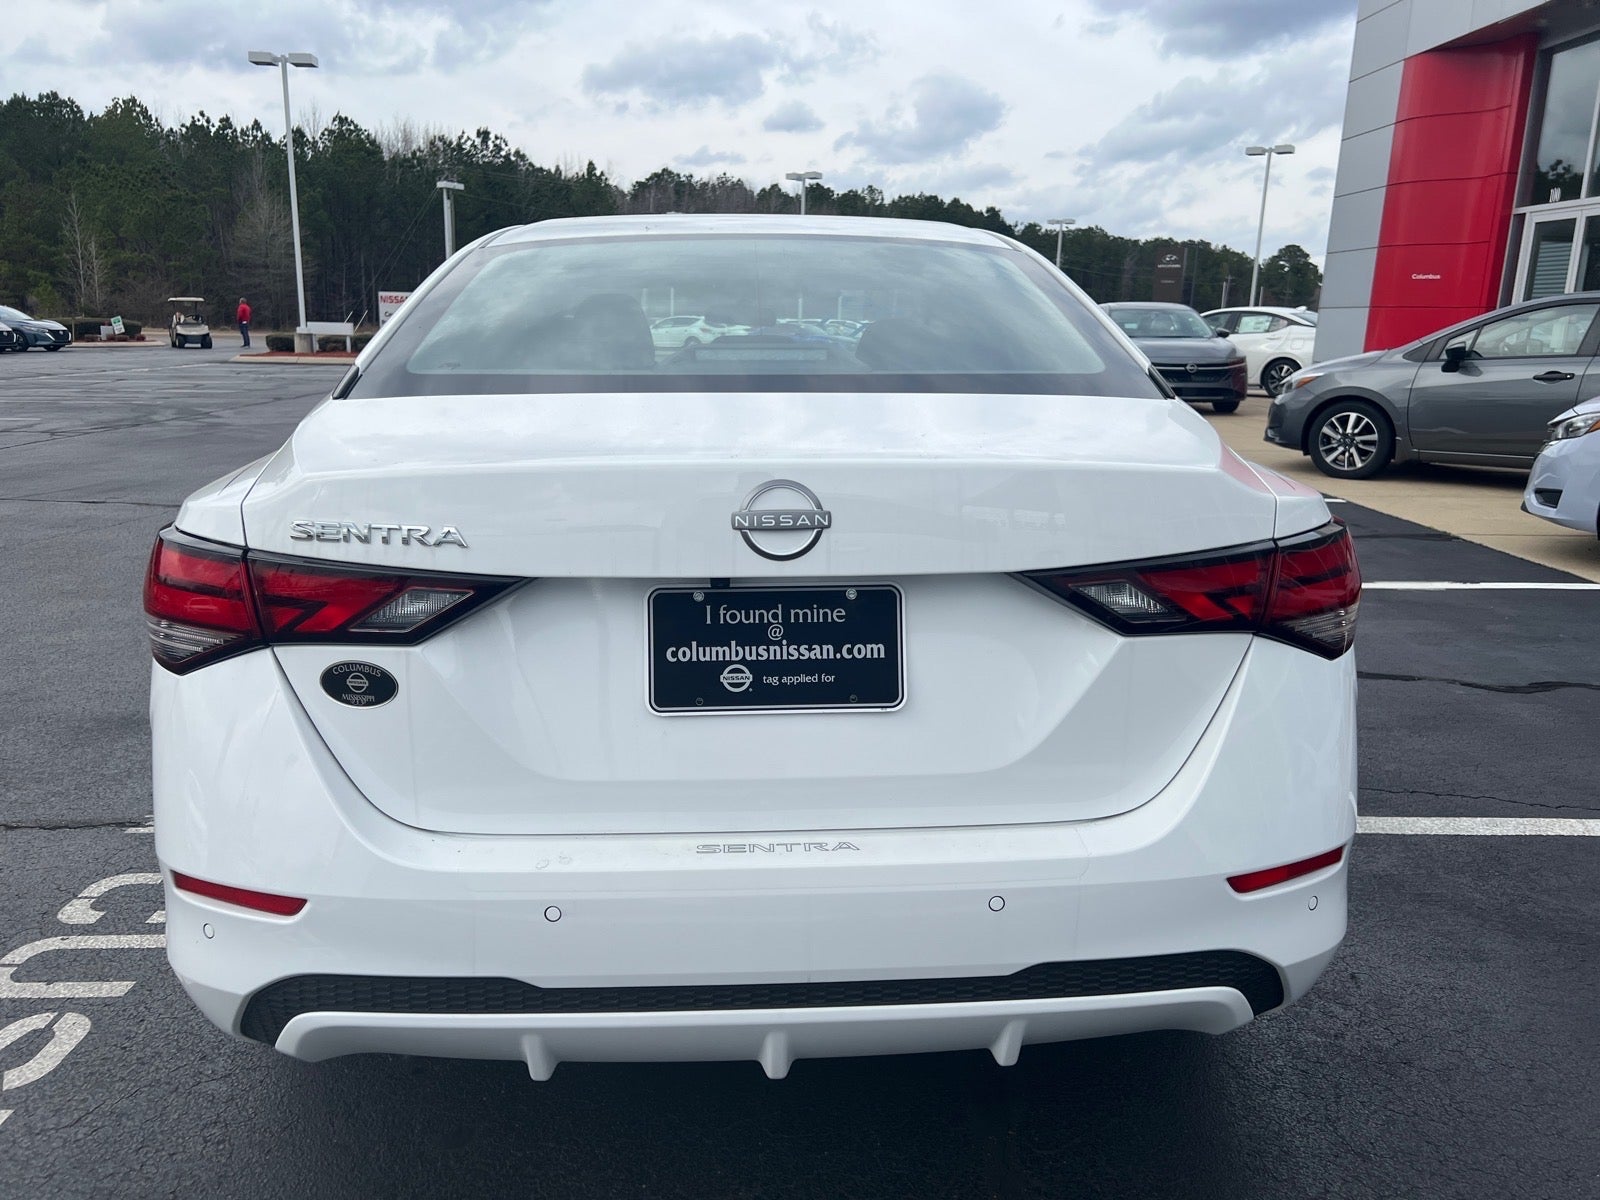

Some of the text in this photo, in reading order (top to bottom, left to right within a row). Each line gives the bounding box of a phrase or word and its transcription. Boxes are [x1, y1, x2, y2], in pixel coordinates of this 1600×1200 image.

[380, 295, 408, 304] NISSA
[734, 514, 829, 527] NISSAN
[290, 520, 469, 549] SENTRA
[706, 604, 846, 625] I found mine
[767, 624, 784, 641] @
[666, 640, 885, 662] columbusnissan.com
[332, 663, 382, 677] COLUMBUS
[722, 674, 751, 682] NISSAN
[763, 673, 836, 685] tag applied for
[696, 841, 861, 854] SENTRA
